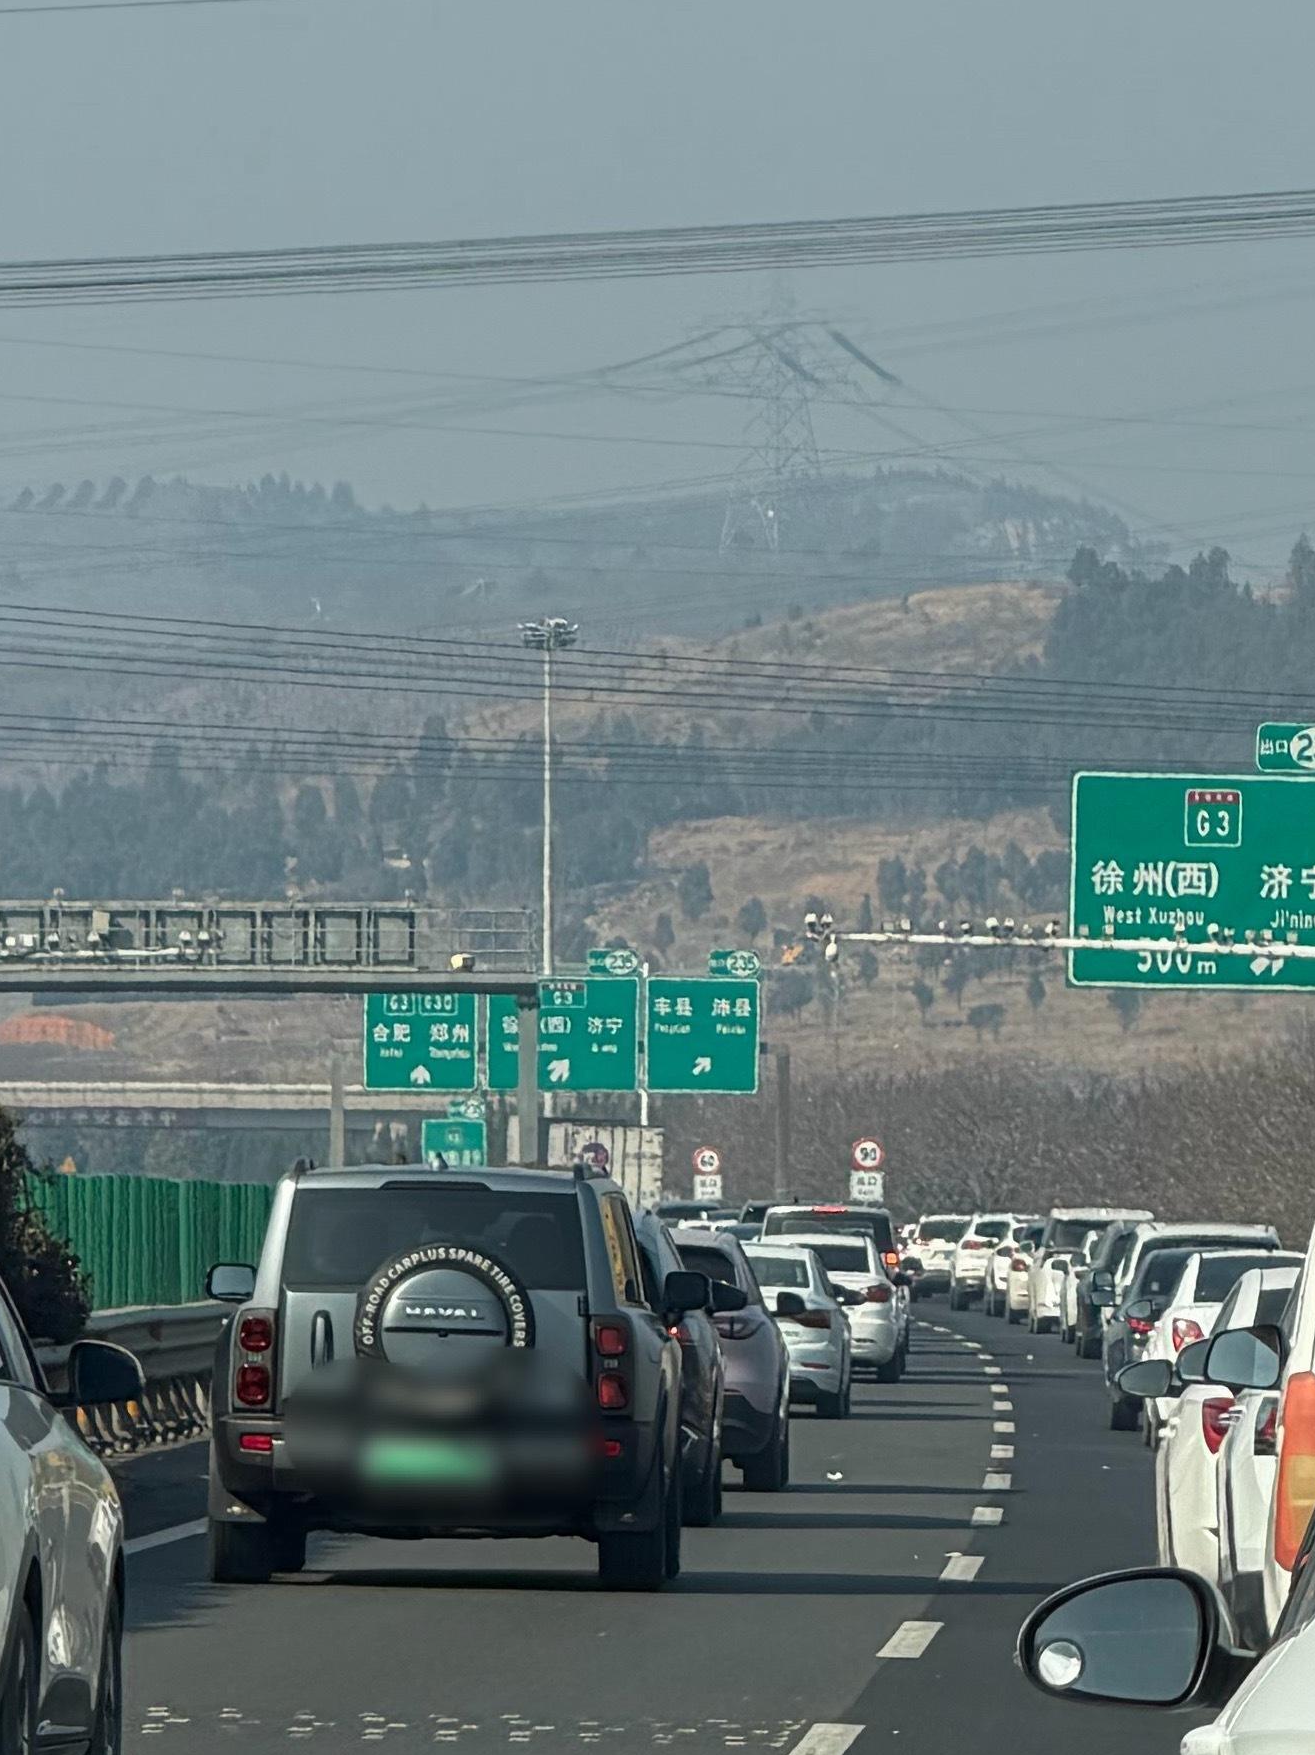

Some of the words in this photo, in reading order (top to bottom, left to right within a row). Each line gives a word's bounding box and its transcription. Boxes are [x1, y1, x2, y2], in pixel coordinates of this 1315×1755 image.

[1260, 738, 1288, 756] 出口
[1197, 808, 1230, 838] G3
[1090, 859, 1219, 899] 徐州(西)
[1102, 905, 1142, 925] West
[1148, 906, 1204, 927] Xuzhou
[607, 953, 634, 971] 235
[729, 954, 757, 972] 235
[372, 1022, 412, 1043] 合肥
[587, 1016, 624, 1036] 济宁
[448, 1247, 493, 1272] SPARE
[489, 1264, 517, 1295] TIRE
[508, 1294, 528, 1347] COVERS
